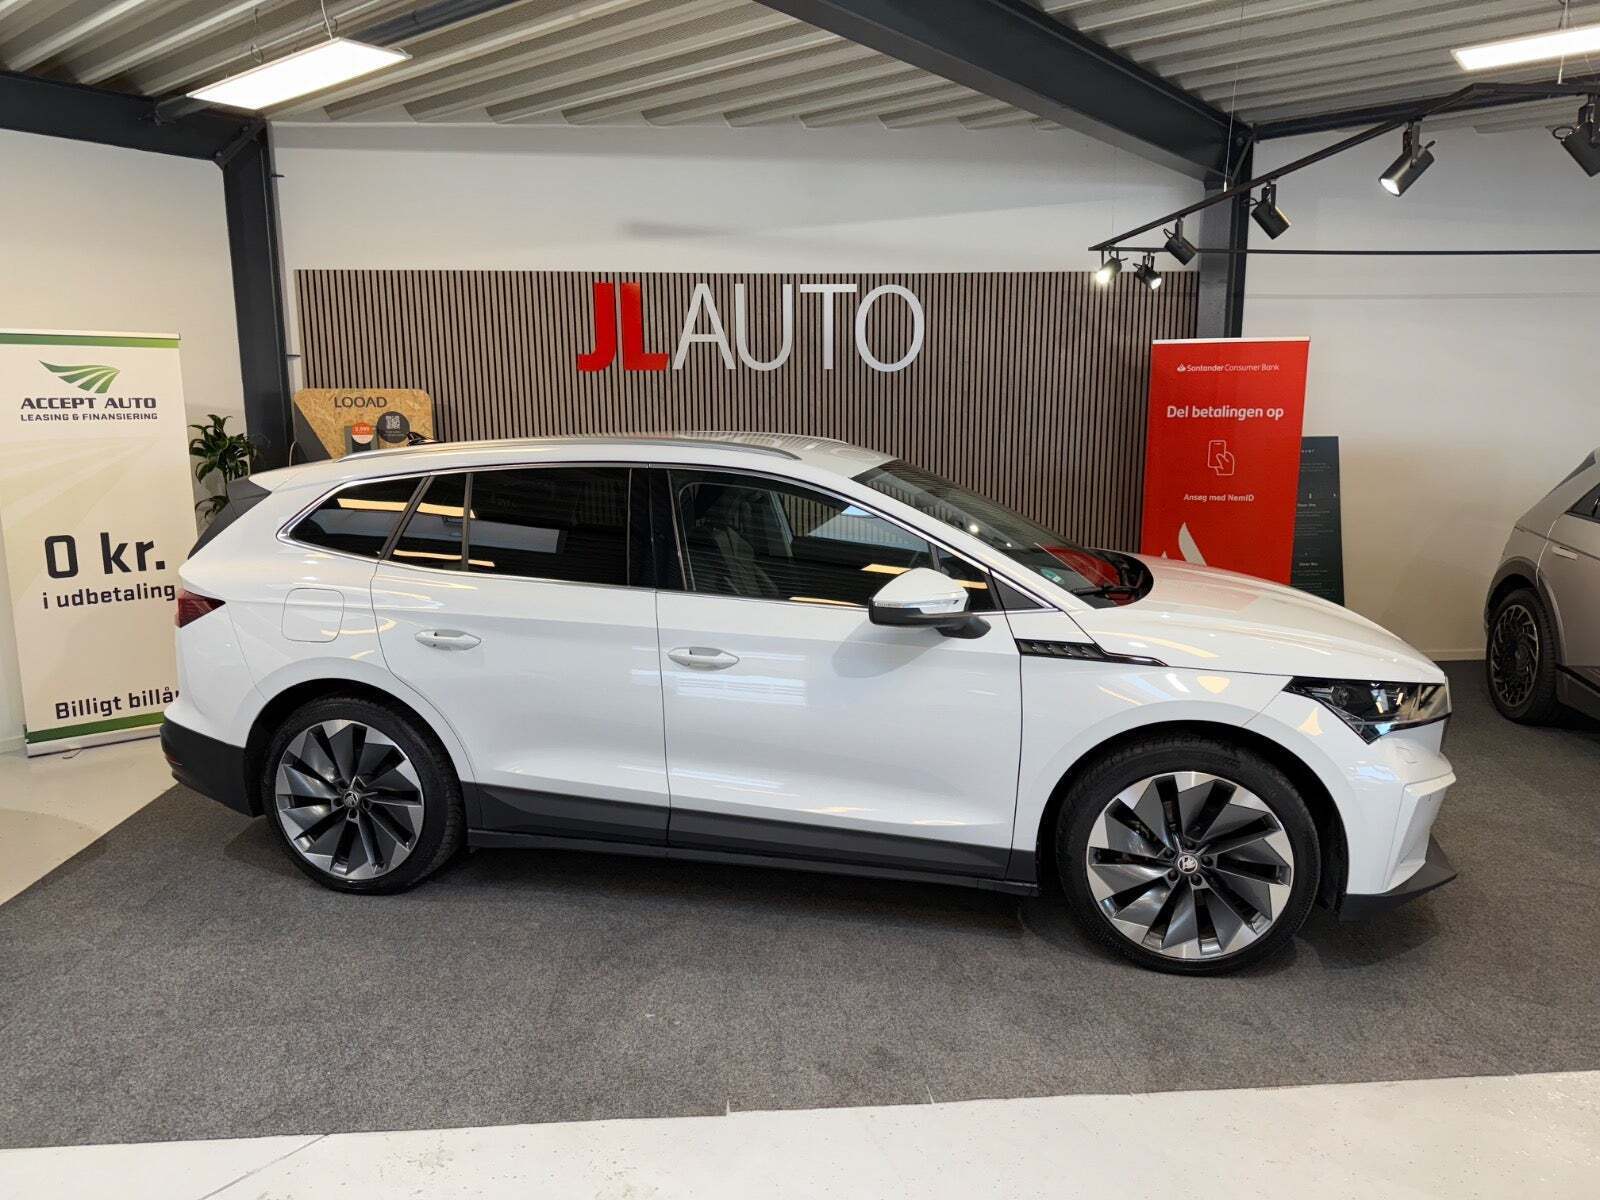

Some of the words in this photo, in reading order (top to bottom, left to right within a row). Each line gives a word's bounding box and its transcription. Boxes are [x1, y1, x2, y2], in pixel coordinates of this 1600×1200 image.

[1187, 364, 1224, 372] Santander
[1224, 363, 1260, 372] Consumer
[1261, 362, 1280, 372] Bank
[20, 397, 97, 410] ACCEPT
[104, 397, 157, 409] AUTO
[334, 396, 388, 408] LOOAD
[20, 413, 70, 422] LEASING
[72, 413, 79, 421] &
[82, 412, 158, 421] FINANSIERING
[1167, 405, 1189, 418] Del
[1191, 405, 1264, 421] betalingen
[1266, 408, 1284, 421] op
[1209, 494, 1226, 502] med
[1228, 494, 1255, 502] NemID
[45, 534, 79, 579] 0
[100, 532, 166, 575] kr.
[43, 592, 48, 609] i
[56, 583, 176, 608] udbetaling
[55, 697, 122, 719] Billigt
